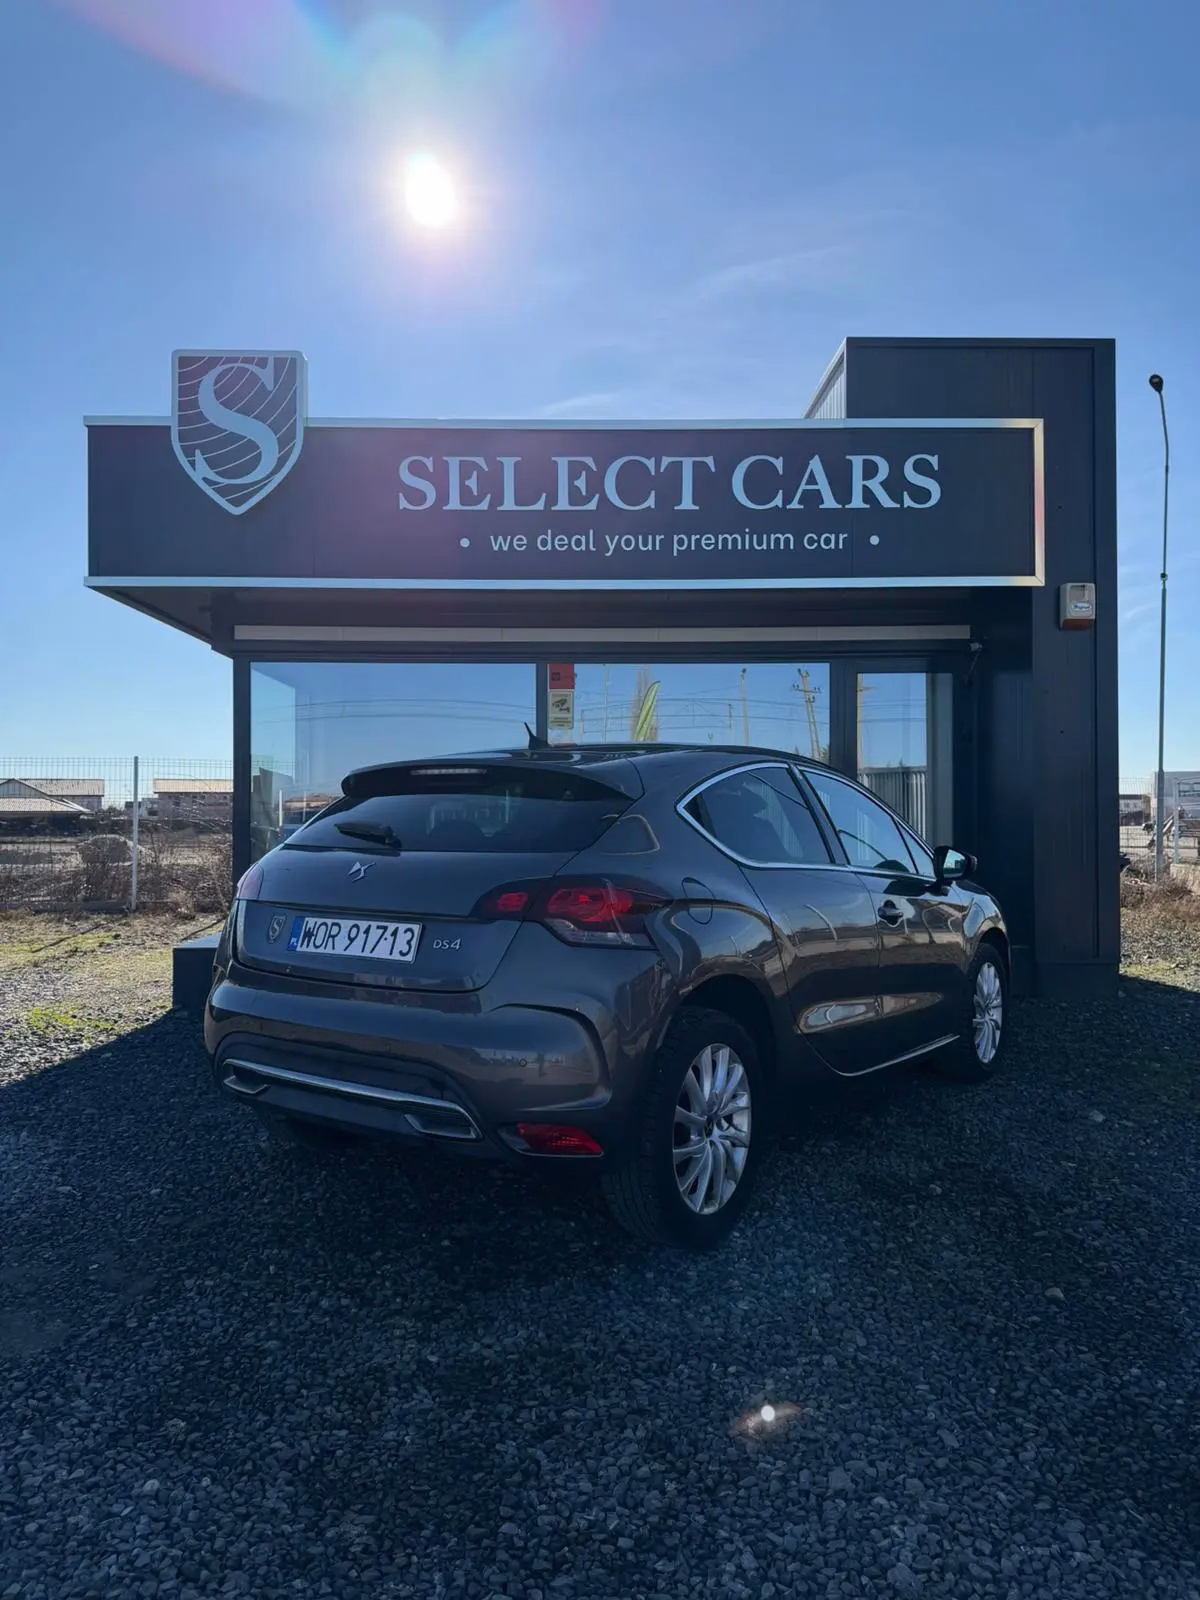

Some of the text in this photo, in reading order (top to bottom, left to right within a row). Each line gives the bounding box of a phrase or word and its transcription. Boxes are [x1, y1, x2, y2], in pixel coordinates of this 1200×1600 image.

[194, 358, 280, 484] S
[398, 453, 941, 511] SELECT CARS
[489, 528, 848, 557] we deal your premium car
[300, 920, 415, 957] WOR 91713
[432, 938, 461, 950] DS4
